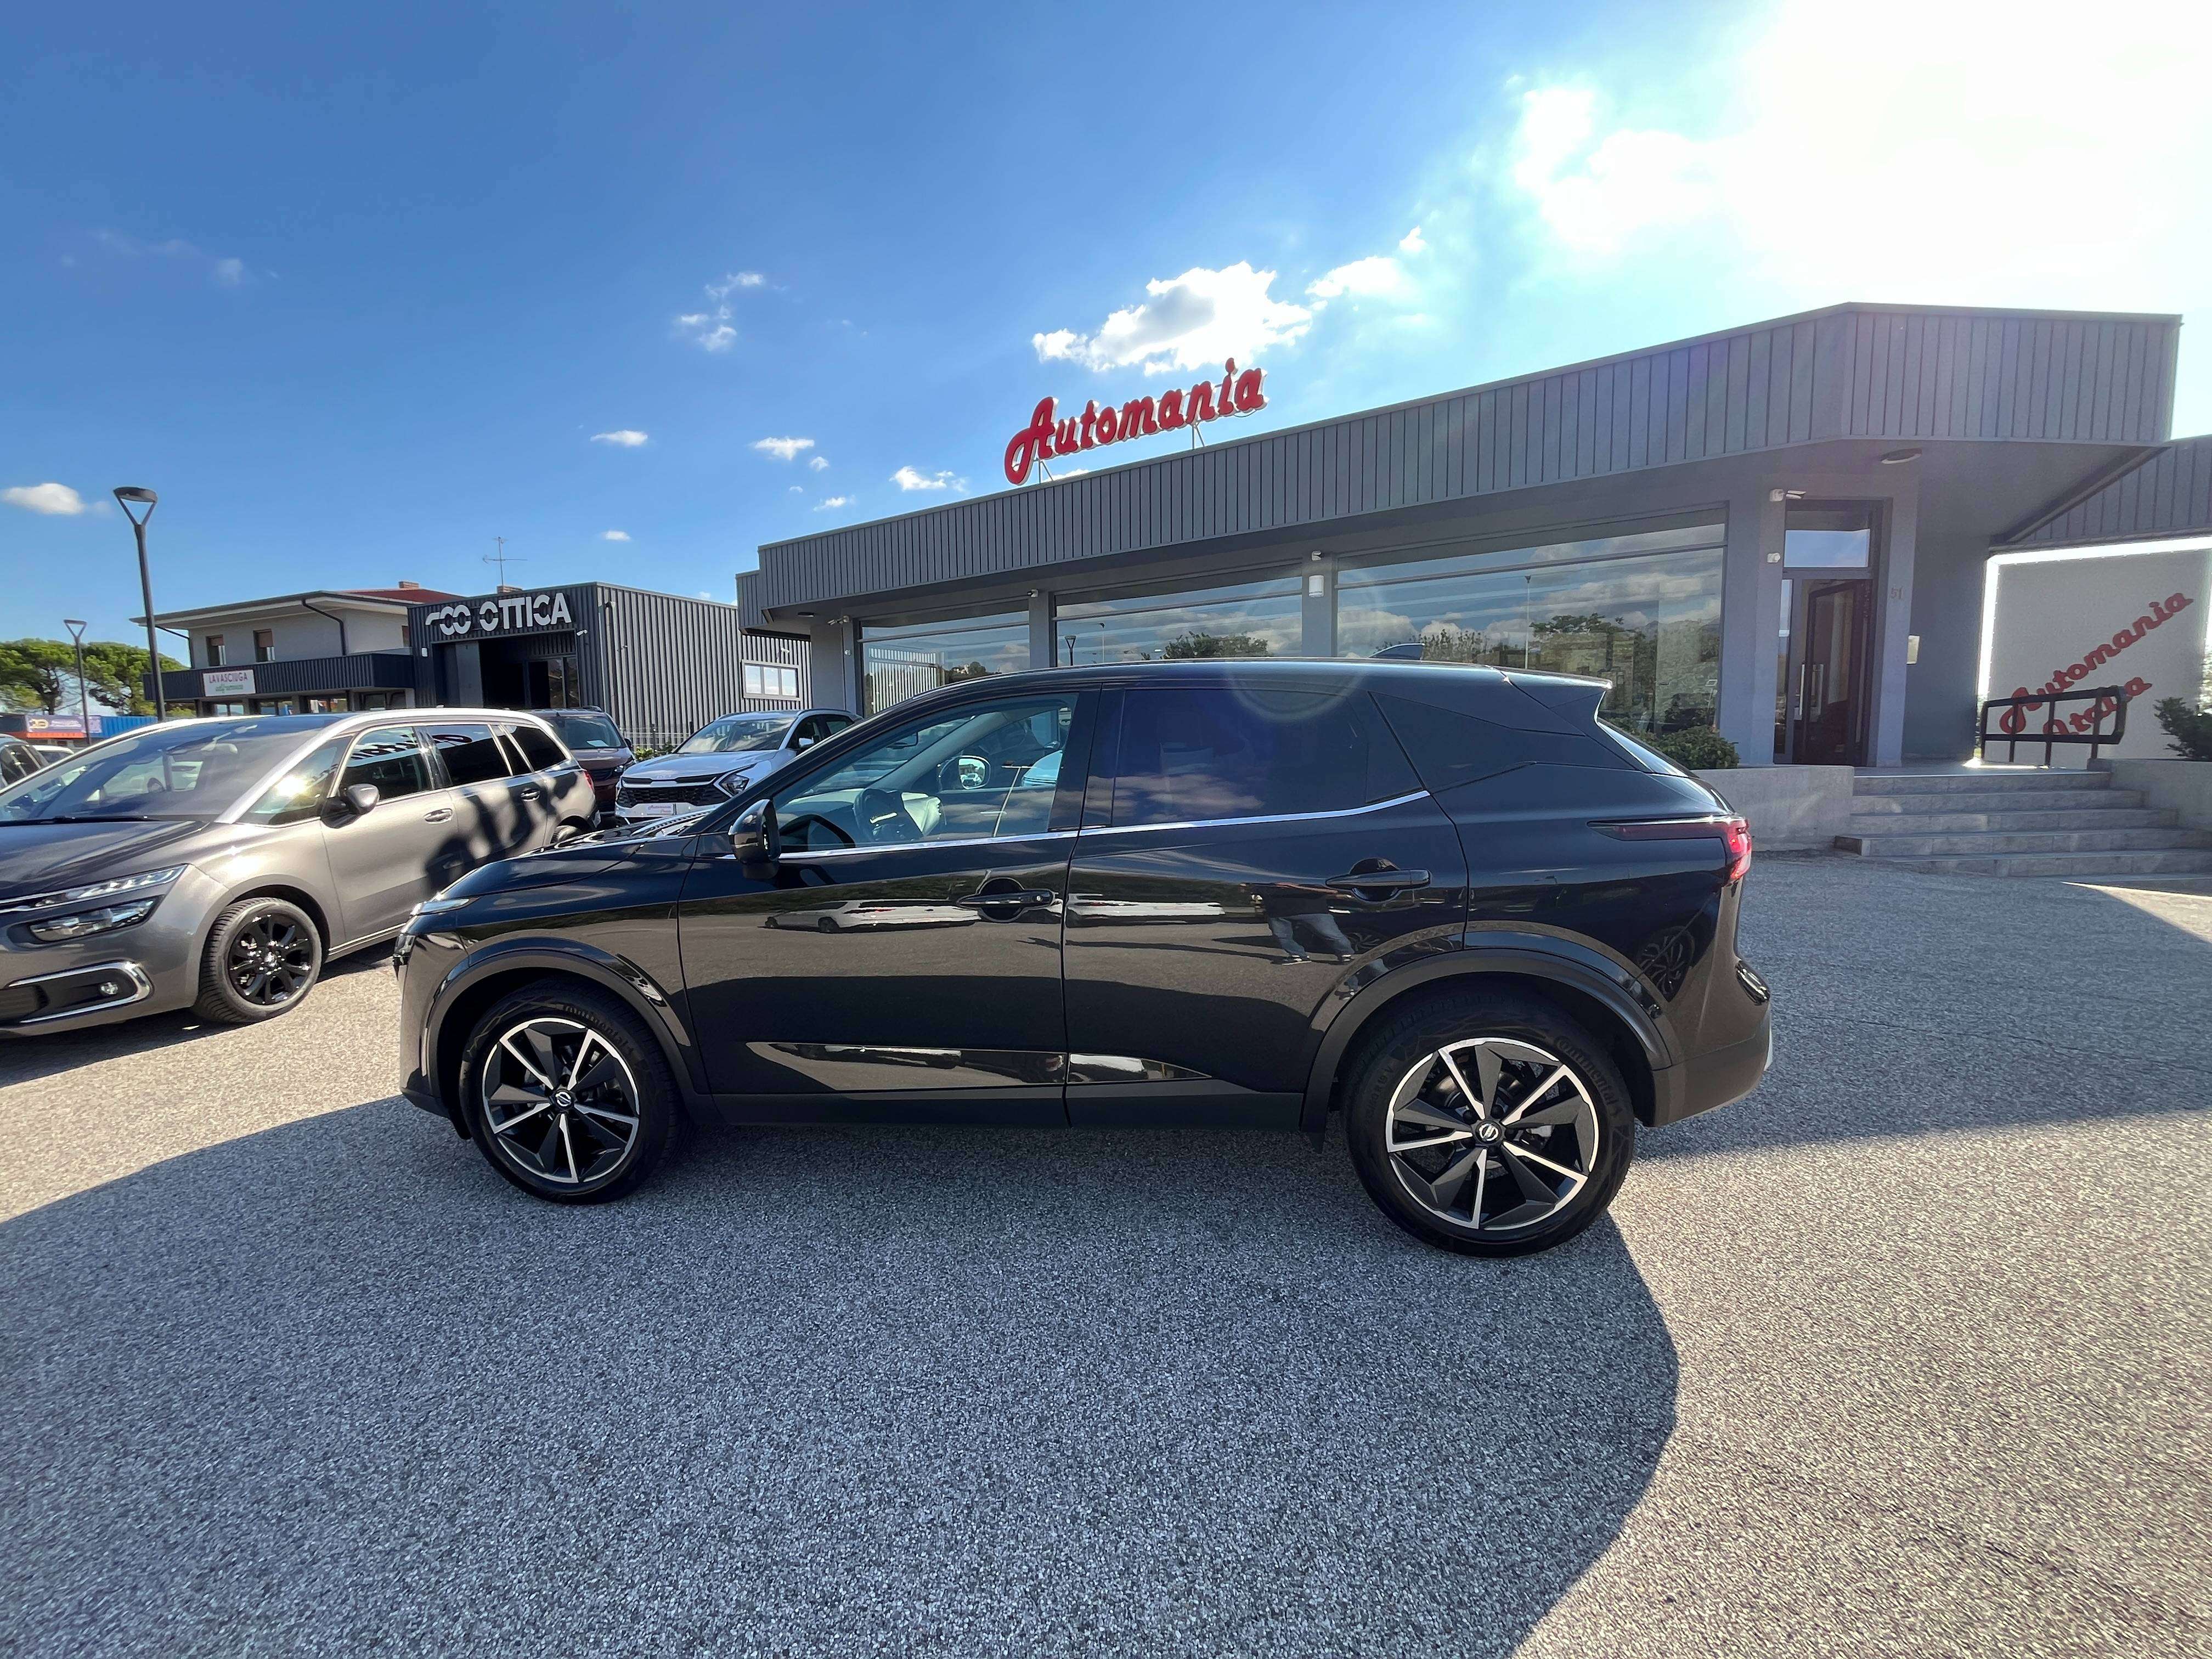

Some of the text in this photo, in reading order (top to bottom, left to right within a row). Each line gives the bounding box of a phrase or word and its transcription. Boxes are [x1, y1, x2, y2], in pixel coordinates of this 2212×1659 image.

[1005, 357, 1268, 486] Automania
[479, 592, 572, 631] OTTICA
[1999, 592, 2194, 735] Automania
